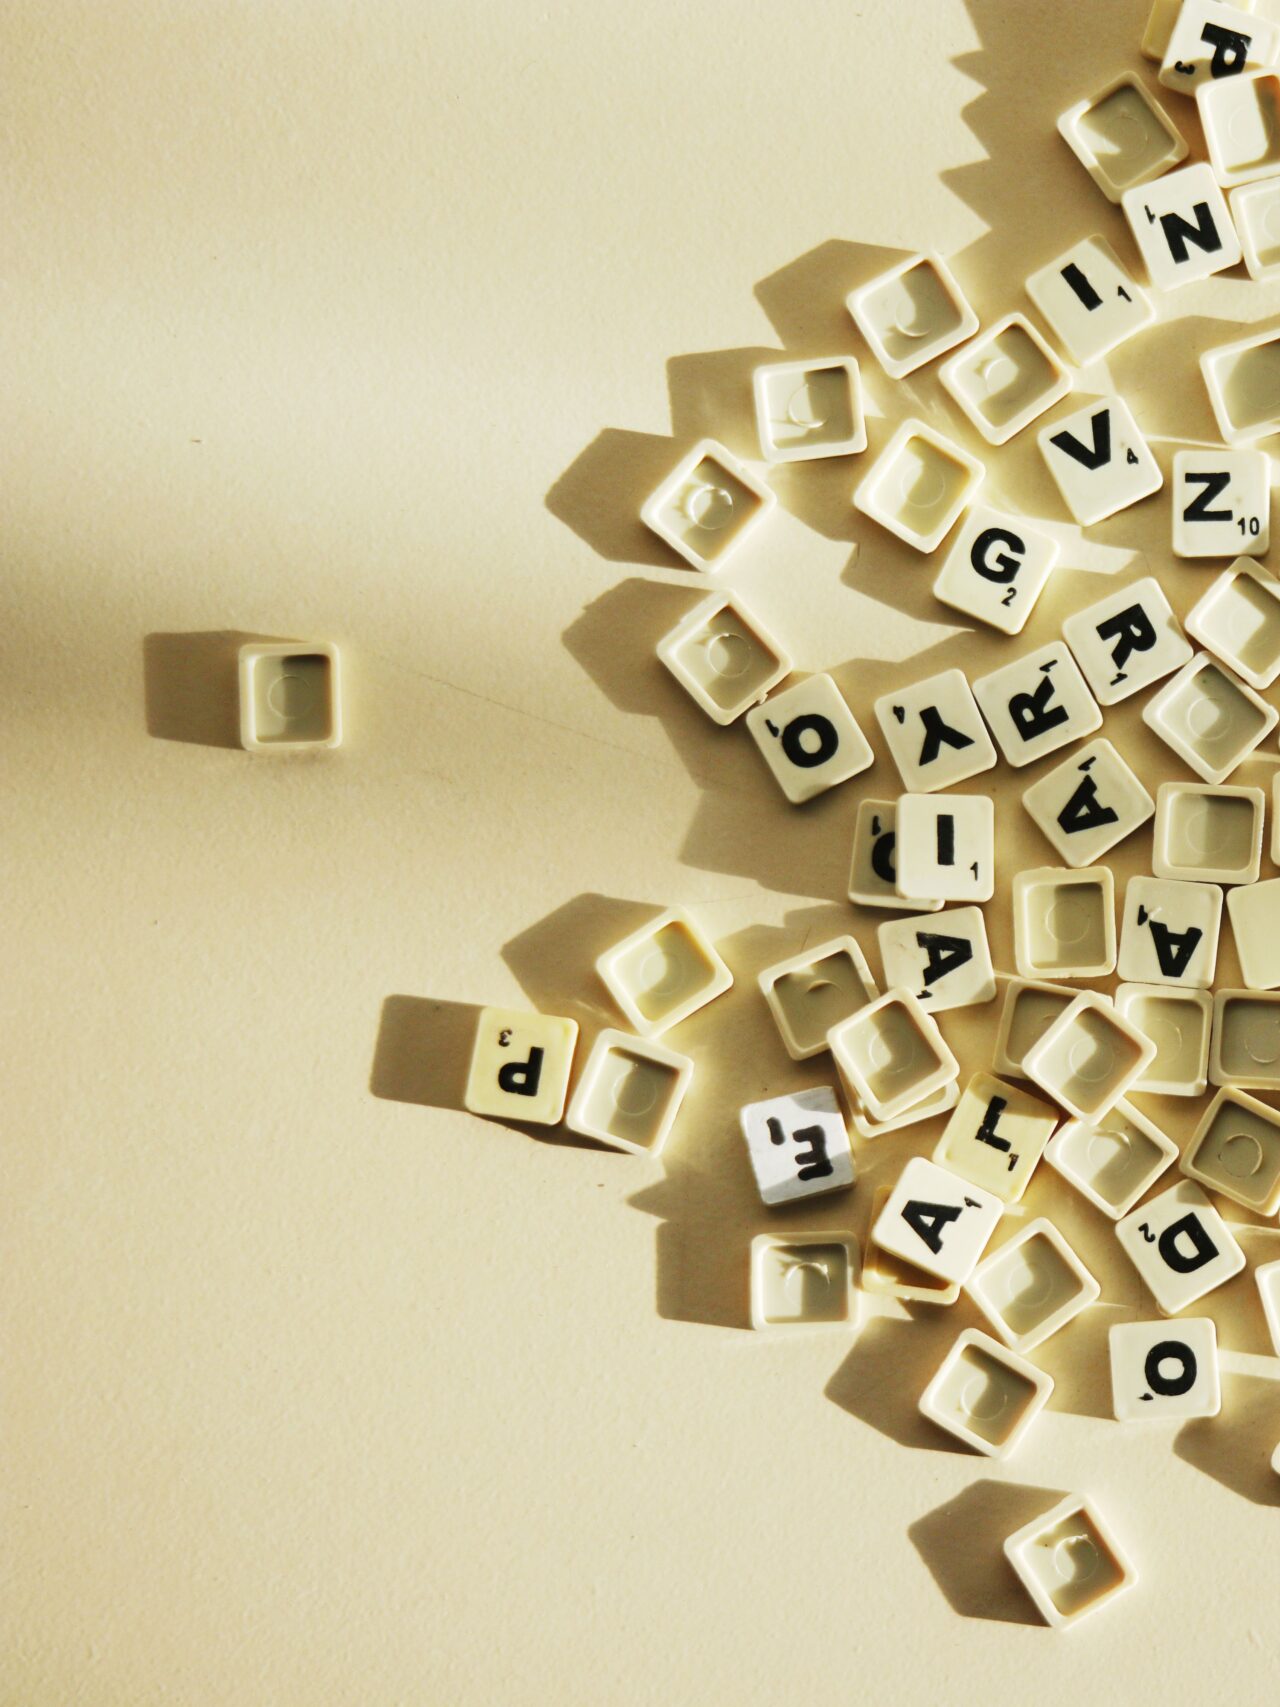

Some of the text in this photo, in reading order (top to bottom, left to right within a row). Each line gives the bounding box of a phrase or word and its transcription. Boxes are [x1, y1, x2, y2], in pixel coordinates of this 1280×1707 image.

[1175, 23, 1251, 79] P 3
[1145, 202, 1221, 263] N 1
[1061, 263, 1131, 311] I 1
[1050, 409, 1138, 470] V 4
[1184, 472, 1260, 535] Z 10
[971, 528, 1025, 606] G 2
[1096, 604, 1156, 685] R 1
[1009, 660, 1069, 742] R 1
[765, 714, 838, 768] O 1
[919, 706, 974, 766] Y
[1057, 756, 1118, 834] A 1
[937, 815, 978, 880] I 1
[916, 932, 972, 986] A
[1137, 905, 1202, 977] A 1
[498, 1047, 543, 1096] P
[793, 1126, 834, 1181] E
[976, 1095, 1018, 1171] L 1
[901, 1200, 962, 1254] A
[1138, 1212, 1219, 1273] D 2
[1145, 1341, 1197, 1396] O
